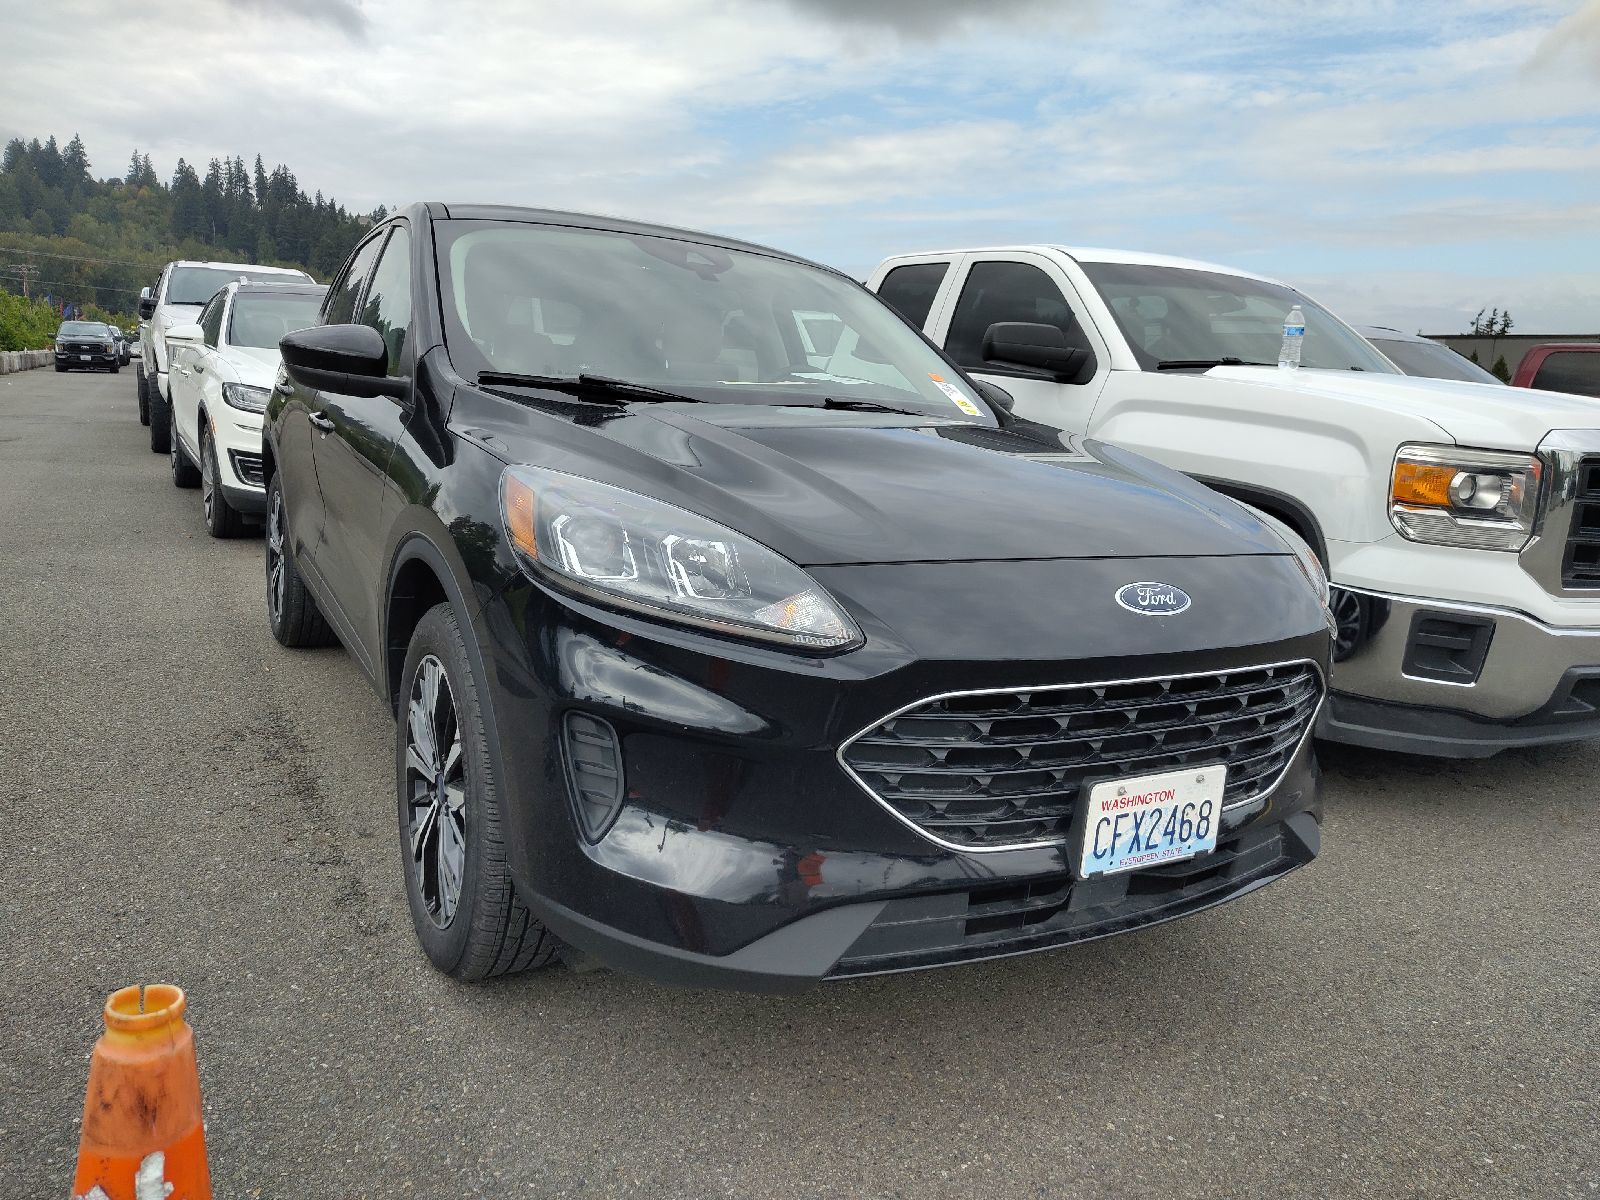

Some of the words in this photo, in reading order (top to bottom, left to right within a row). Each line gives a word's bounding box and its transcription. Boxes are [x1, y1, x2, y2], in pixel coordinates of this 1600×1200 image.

[1137, 587, 1177, 606] Ford
[1101, 789, 1176, 812] WASHINGTON
[1093, 799, 1213, 860] CFX2468
